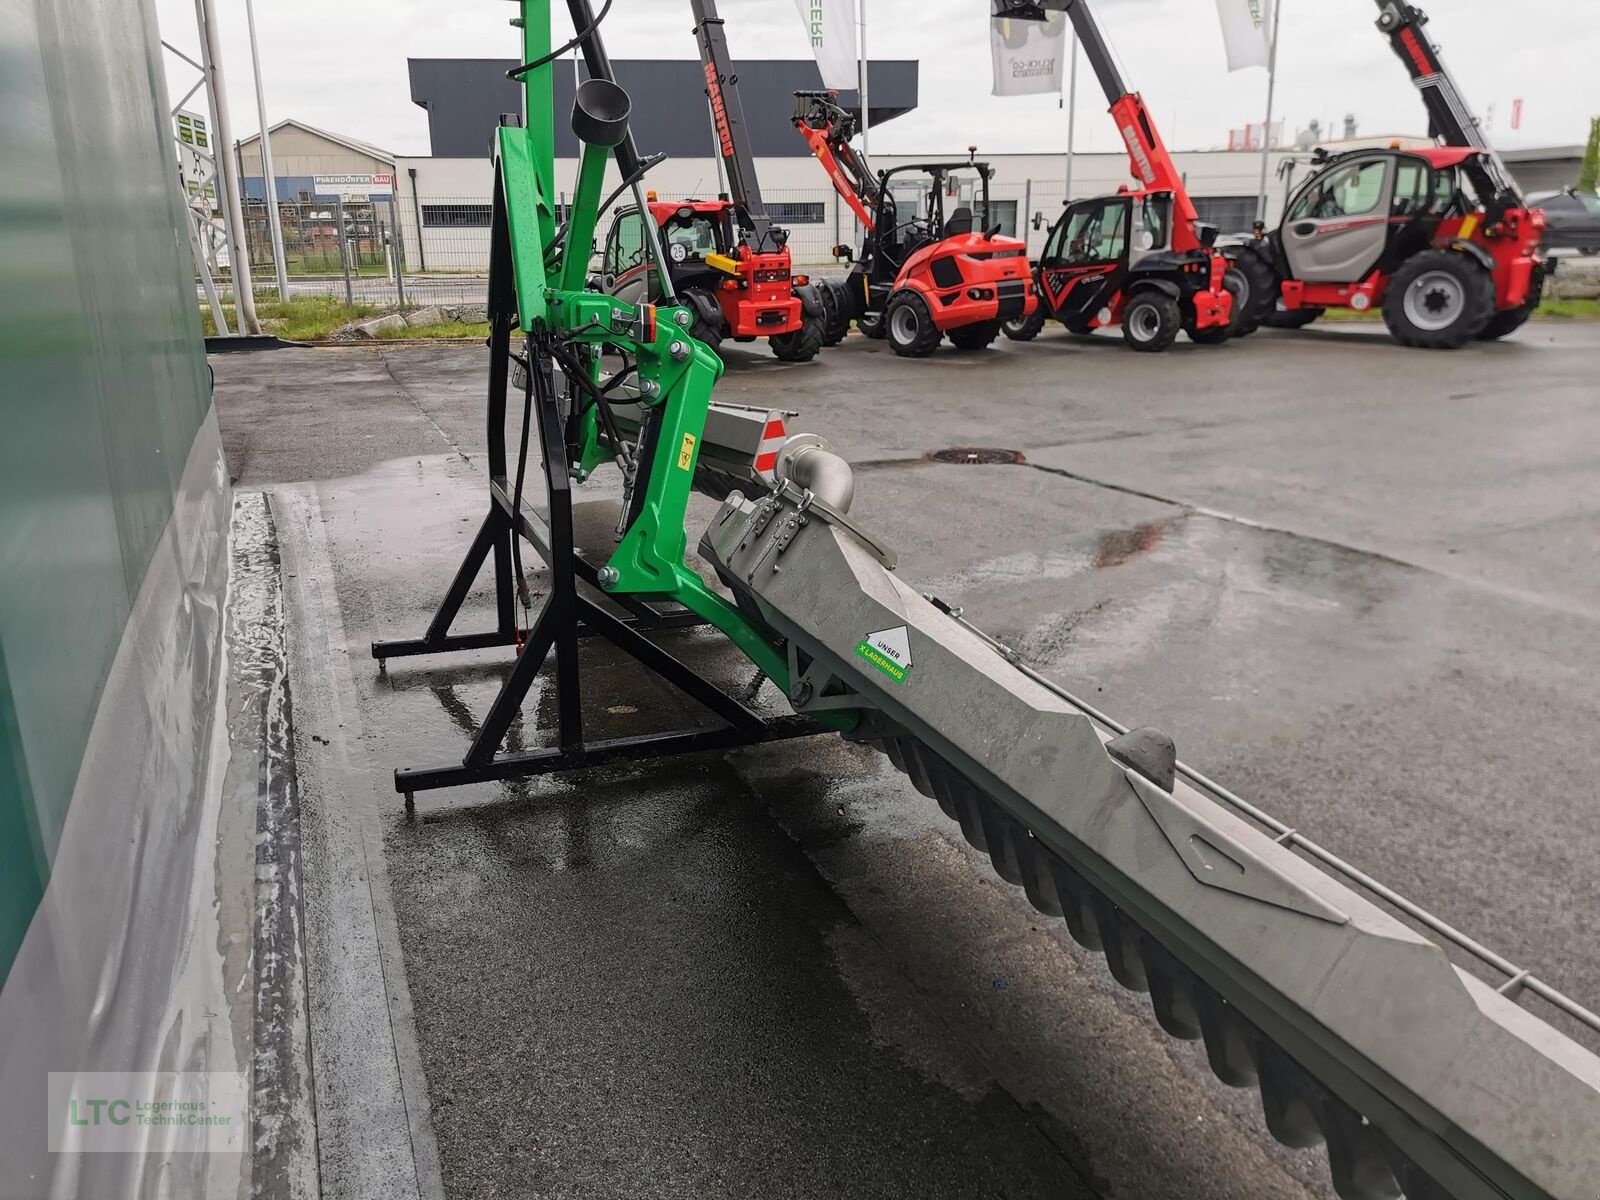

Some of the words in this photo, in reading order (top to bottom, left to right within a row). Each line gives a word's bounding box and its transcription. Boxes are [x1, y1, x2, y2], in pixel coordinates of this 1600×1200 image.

[704, 62, 734, 157] MANITOU
[673, 246, 684, 258] 25
[877, 641, 901, 660] UNSER
[864, 649, 904, 679] LAGERHAUS
